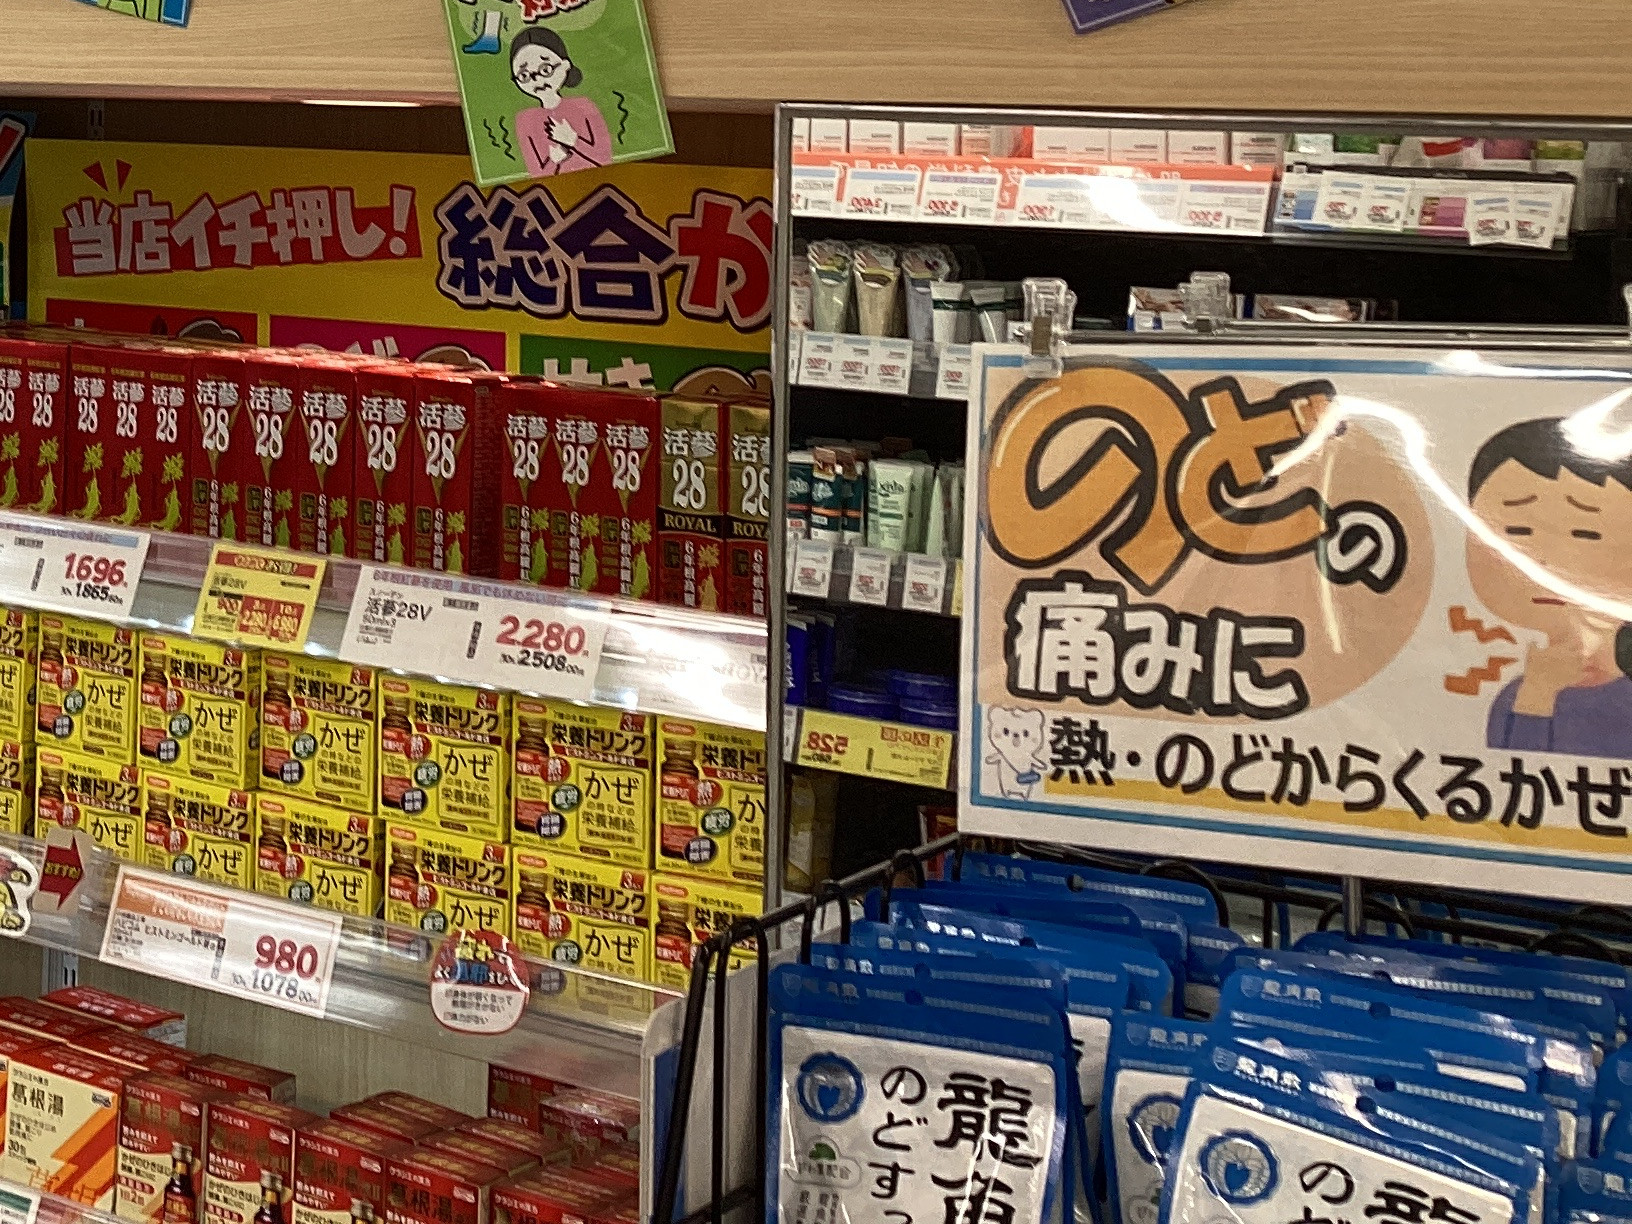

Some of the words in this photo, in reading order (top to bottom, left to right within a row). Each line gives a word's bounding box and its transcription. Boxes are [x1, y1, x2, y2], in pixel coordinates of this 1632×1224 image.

[63, 186, 415, 277] 当店イチ押し!
[33, 392, 53, 428] 28
[117, 401, 137, 438] 28
[202, 406, 230, 452] 28
[309, 420, 338, 466] 28
[426, 431, 455, 479] 28
[562, 443, 590, 486] 28
[672, 459, 707, 509] 28
[663, 514, 716, 534] ROYAL
[1006, 571, 1309, 721] 痛みに
[169, 656, 243, 688] 栄養ドリンク
[293, 675, 370, 706] 栄養ドリンク
[194, 700, 238, 734] かぜ
[319, 720, 365, 754] かぜ
[552, 722, 645, 755] 栄養ドリンク
[66, 772, 139, 802] 栄養ドリンク
[584, 770, 639, 806] かぜ
[173, 796, 248, 829] 栄養ドリンク
[91, 816, 131, 848] かぜ
[198, 840, 243, 874] かぜ
[421, 850, 506, 885] 栄養ドリンク
[552, 876, 646, 912] 栄養ドリンク
[449, 896, 500, 930] かぜ
[255, 935, 319, 979] 980
[584, 926, 640, 963] かぜ
[11, 1087, 64, 1118] 葛根湯
